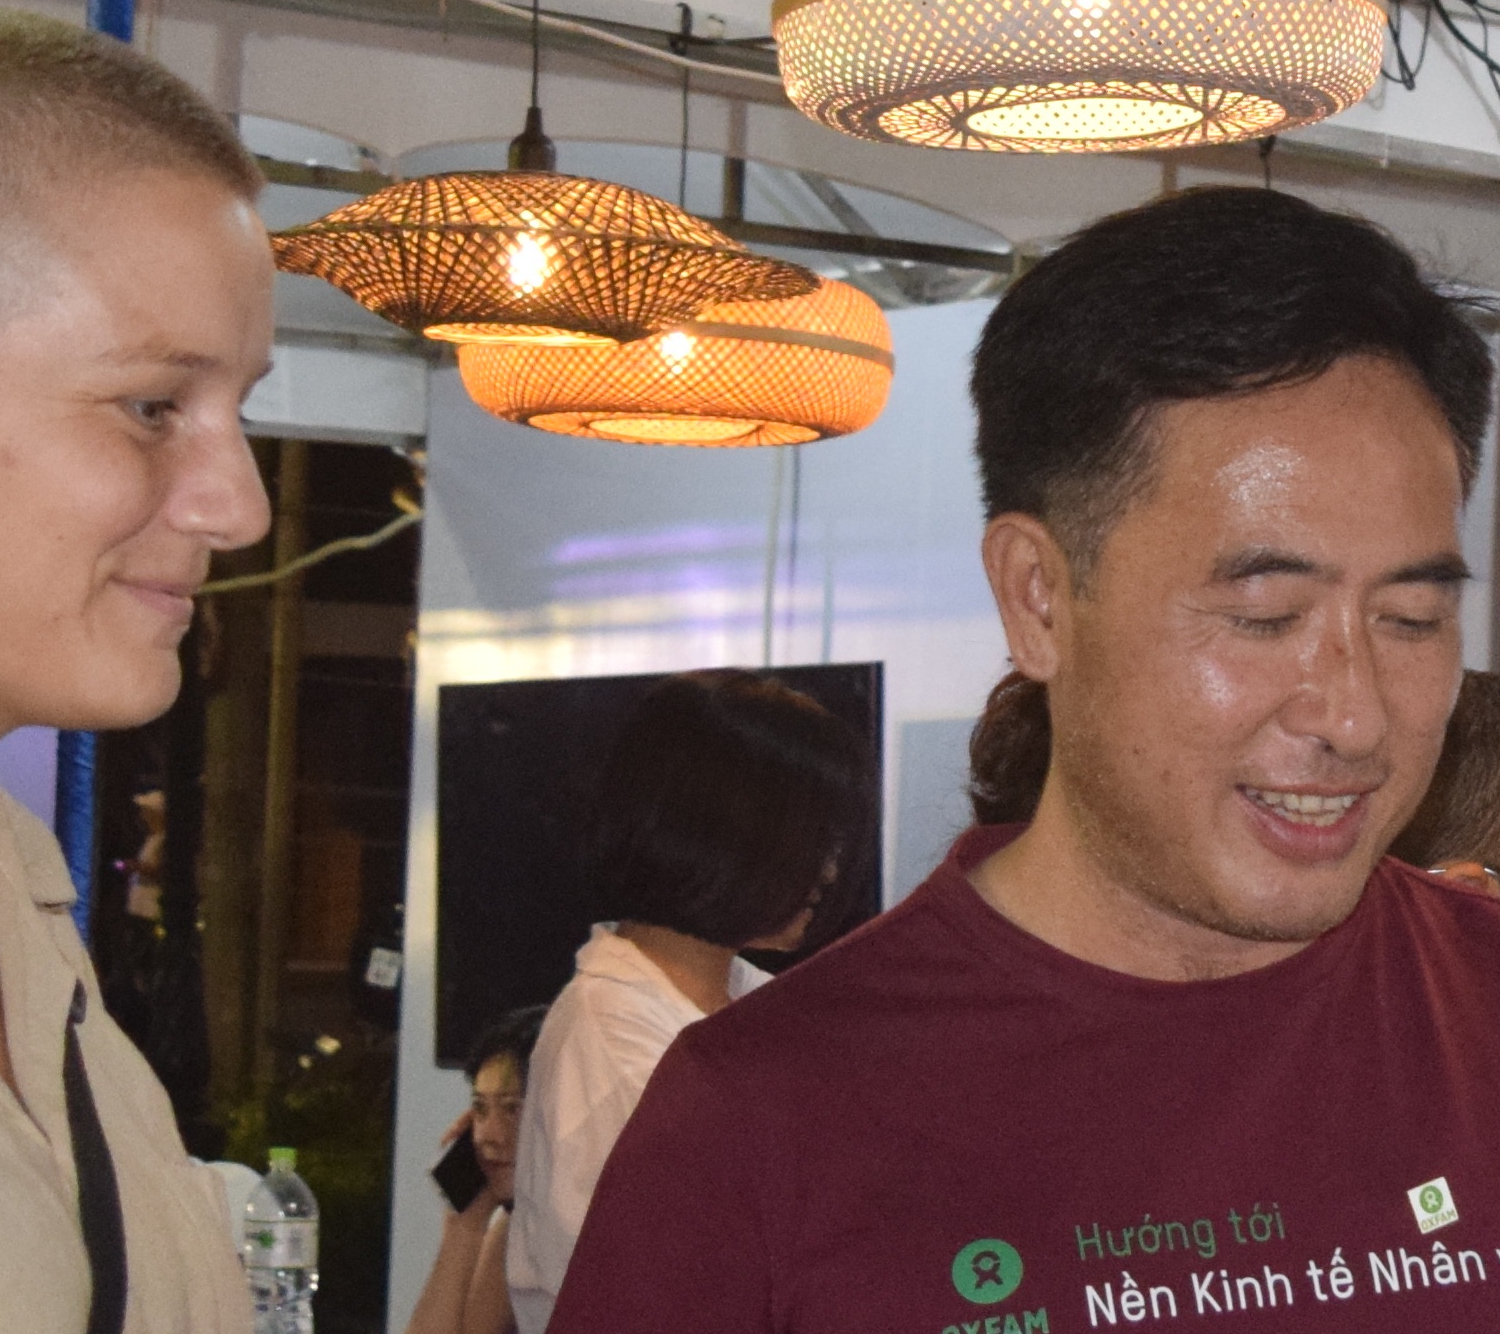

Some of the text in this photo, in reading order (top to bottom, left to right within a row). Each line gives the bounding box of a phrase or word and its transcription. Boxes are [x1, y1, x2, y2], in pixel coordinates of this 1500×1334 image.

[1074, 1201, 1286, 1261] Hướng tới
[1084, 1270, 1178, 1328] Nền
[1191, 1265, 1294, 1315] Kinh
[1306, 1246, 1356, 1304] tế
[1369, 1240, 1487, 1295] Nhân
